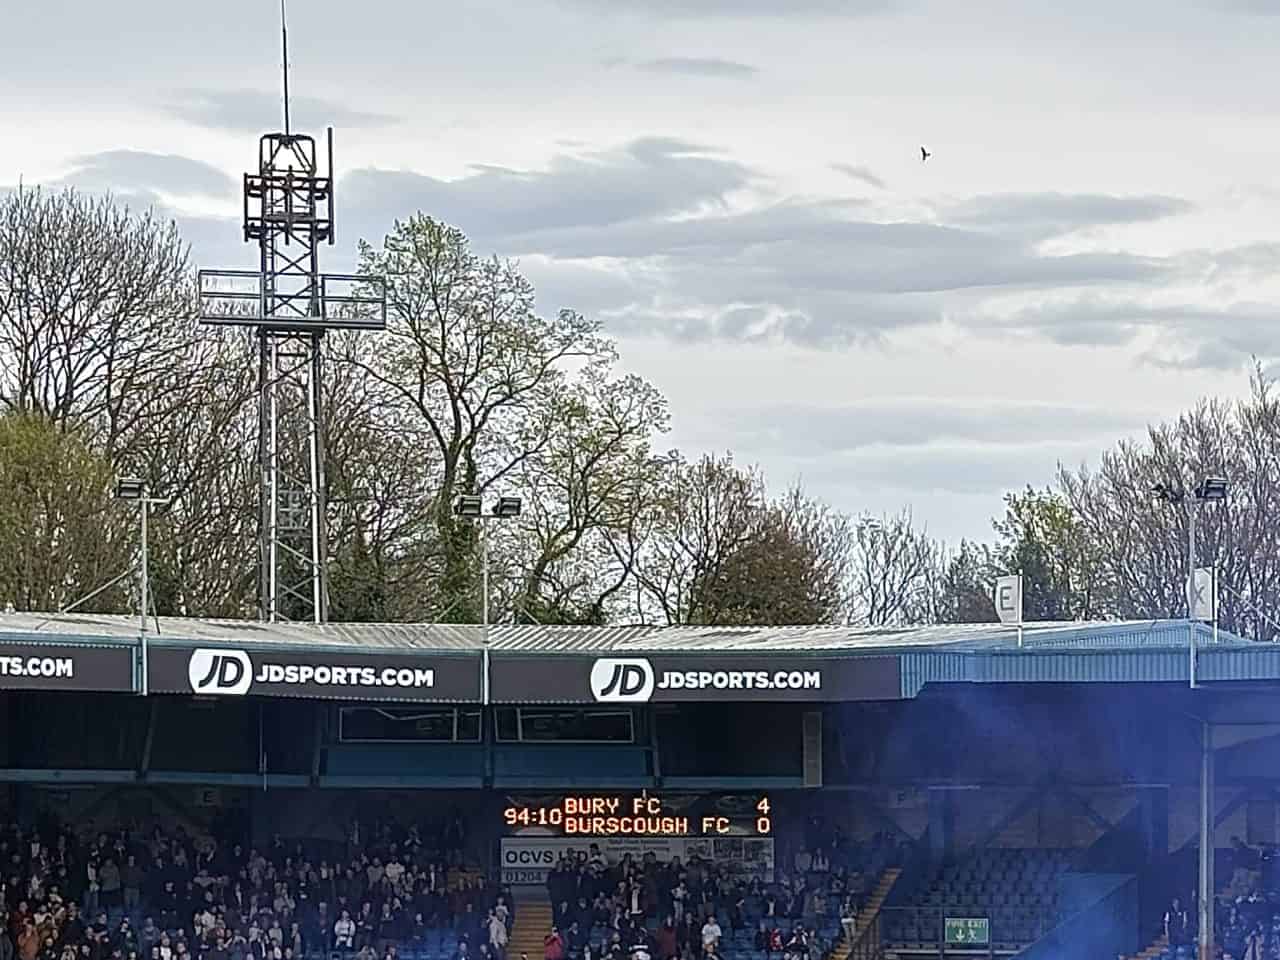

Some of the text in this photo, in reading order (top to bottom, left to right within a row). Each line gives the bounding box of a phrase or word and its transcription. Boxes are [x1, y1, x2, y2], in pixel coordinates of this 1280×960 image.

[1000, 585, 1014, 610] E
[0, 656, 73, 677] TS.COM
[199, 655, 244, 687] JD
[255, 664, 434, 688] JDSPORTS.COM
[601, 664, 646, 696] JD
[657, 671, 821, 689] JDSPORTS.COM
[564, 797, 771, 814] BURY FC 4
[504, 808, 562, 825] 94:10
[564, 817, 771, 834] BURSCOUGH FC 0
[505, 850, 588, 864] OCVS LD
